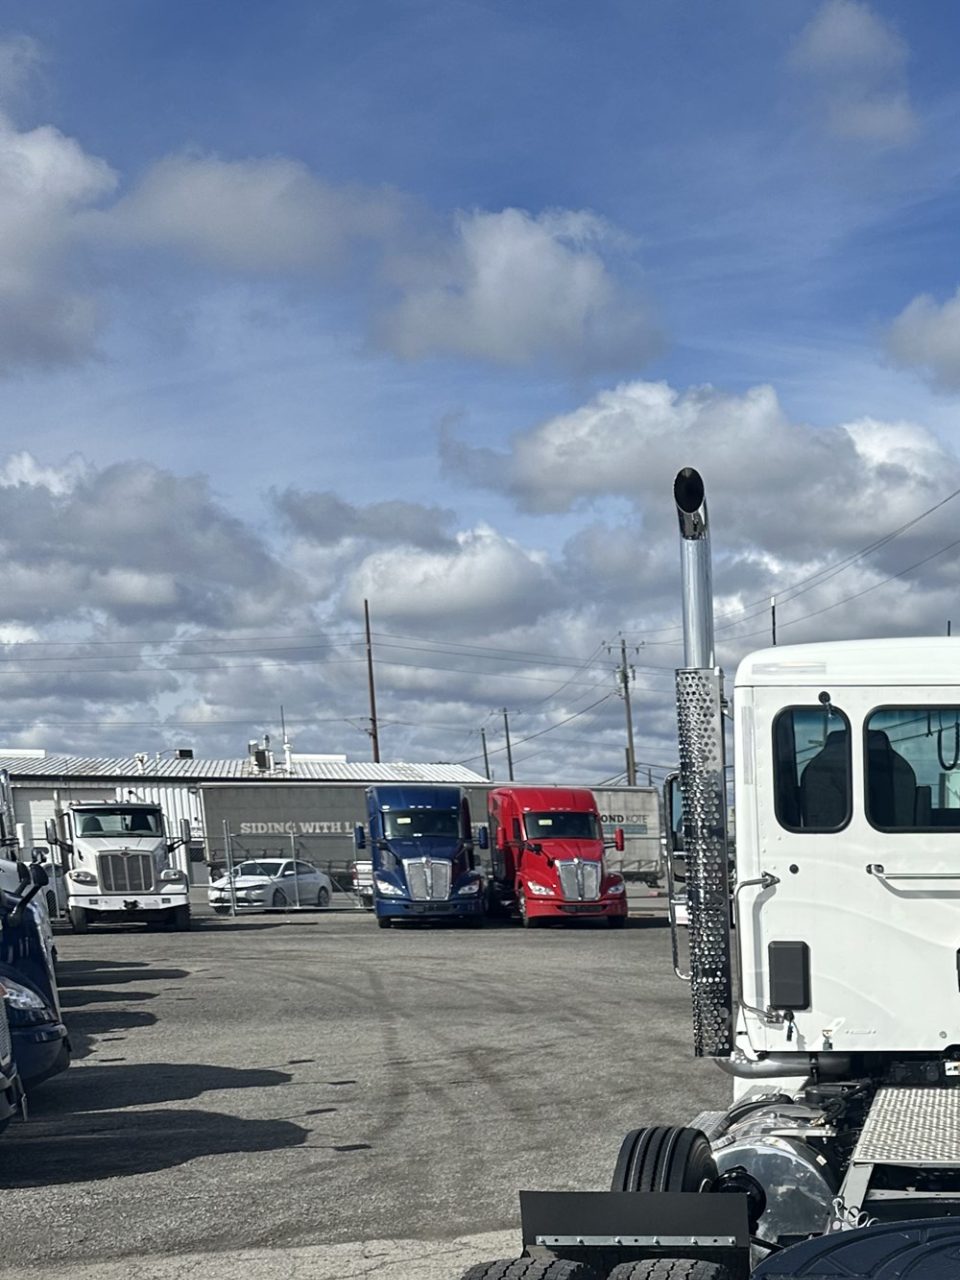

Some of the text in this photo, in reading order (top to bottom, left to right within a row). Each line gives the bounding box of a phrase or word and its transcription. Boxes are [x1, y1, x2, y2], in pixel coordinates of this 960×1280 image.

[601, 814, 624, 823] OND
[240, 822, 296, 834] SIDING
[300, 822, 341, 833] WITH
